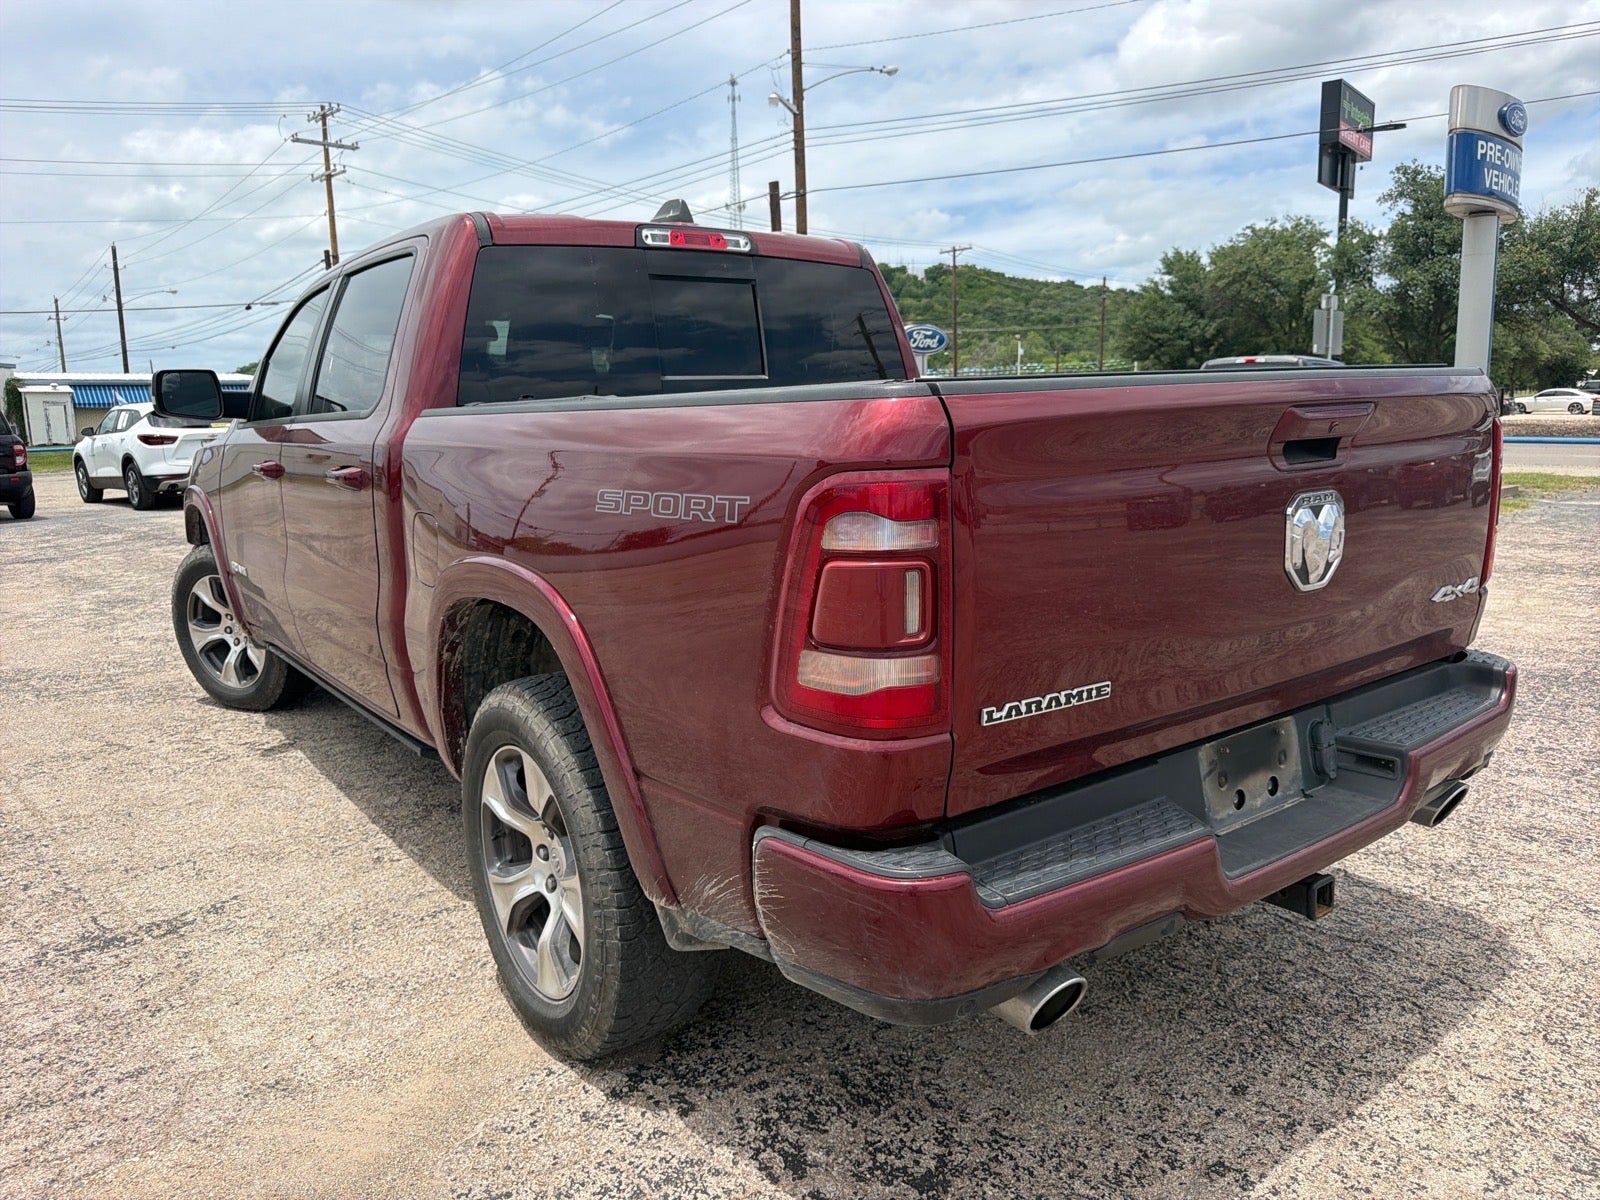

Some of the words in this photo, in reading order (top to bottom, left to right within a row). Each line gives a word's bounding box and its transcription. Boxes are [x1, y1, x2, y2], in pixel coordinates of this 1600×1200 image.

[1477, 140, 1522, 175] PRE-OWN
[1484, 167, 1521, 199] VEHICLE
[910, 330, 940, 348] Ford
[595, 489, 750, 523] SPORT
[1302, 492, 1335, 504] RAM
[981, 681, 1112, 726] LARAMIE
